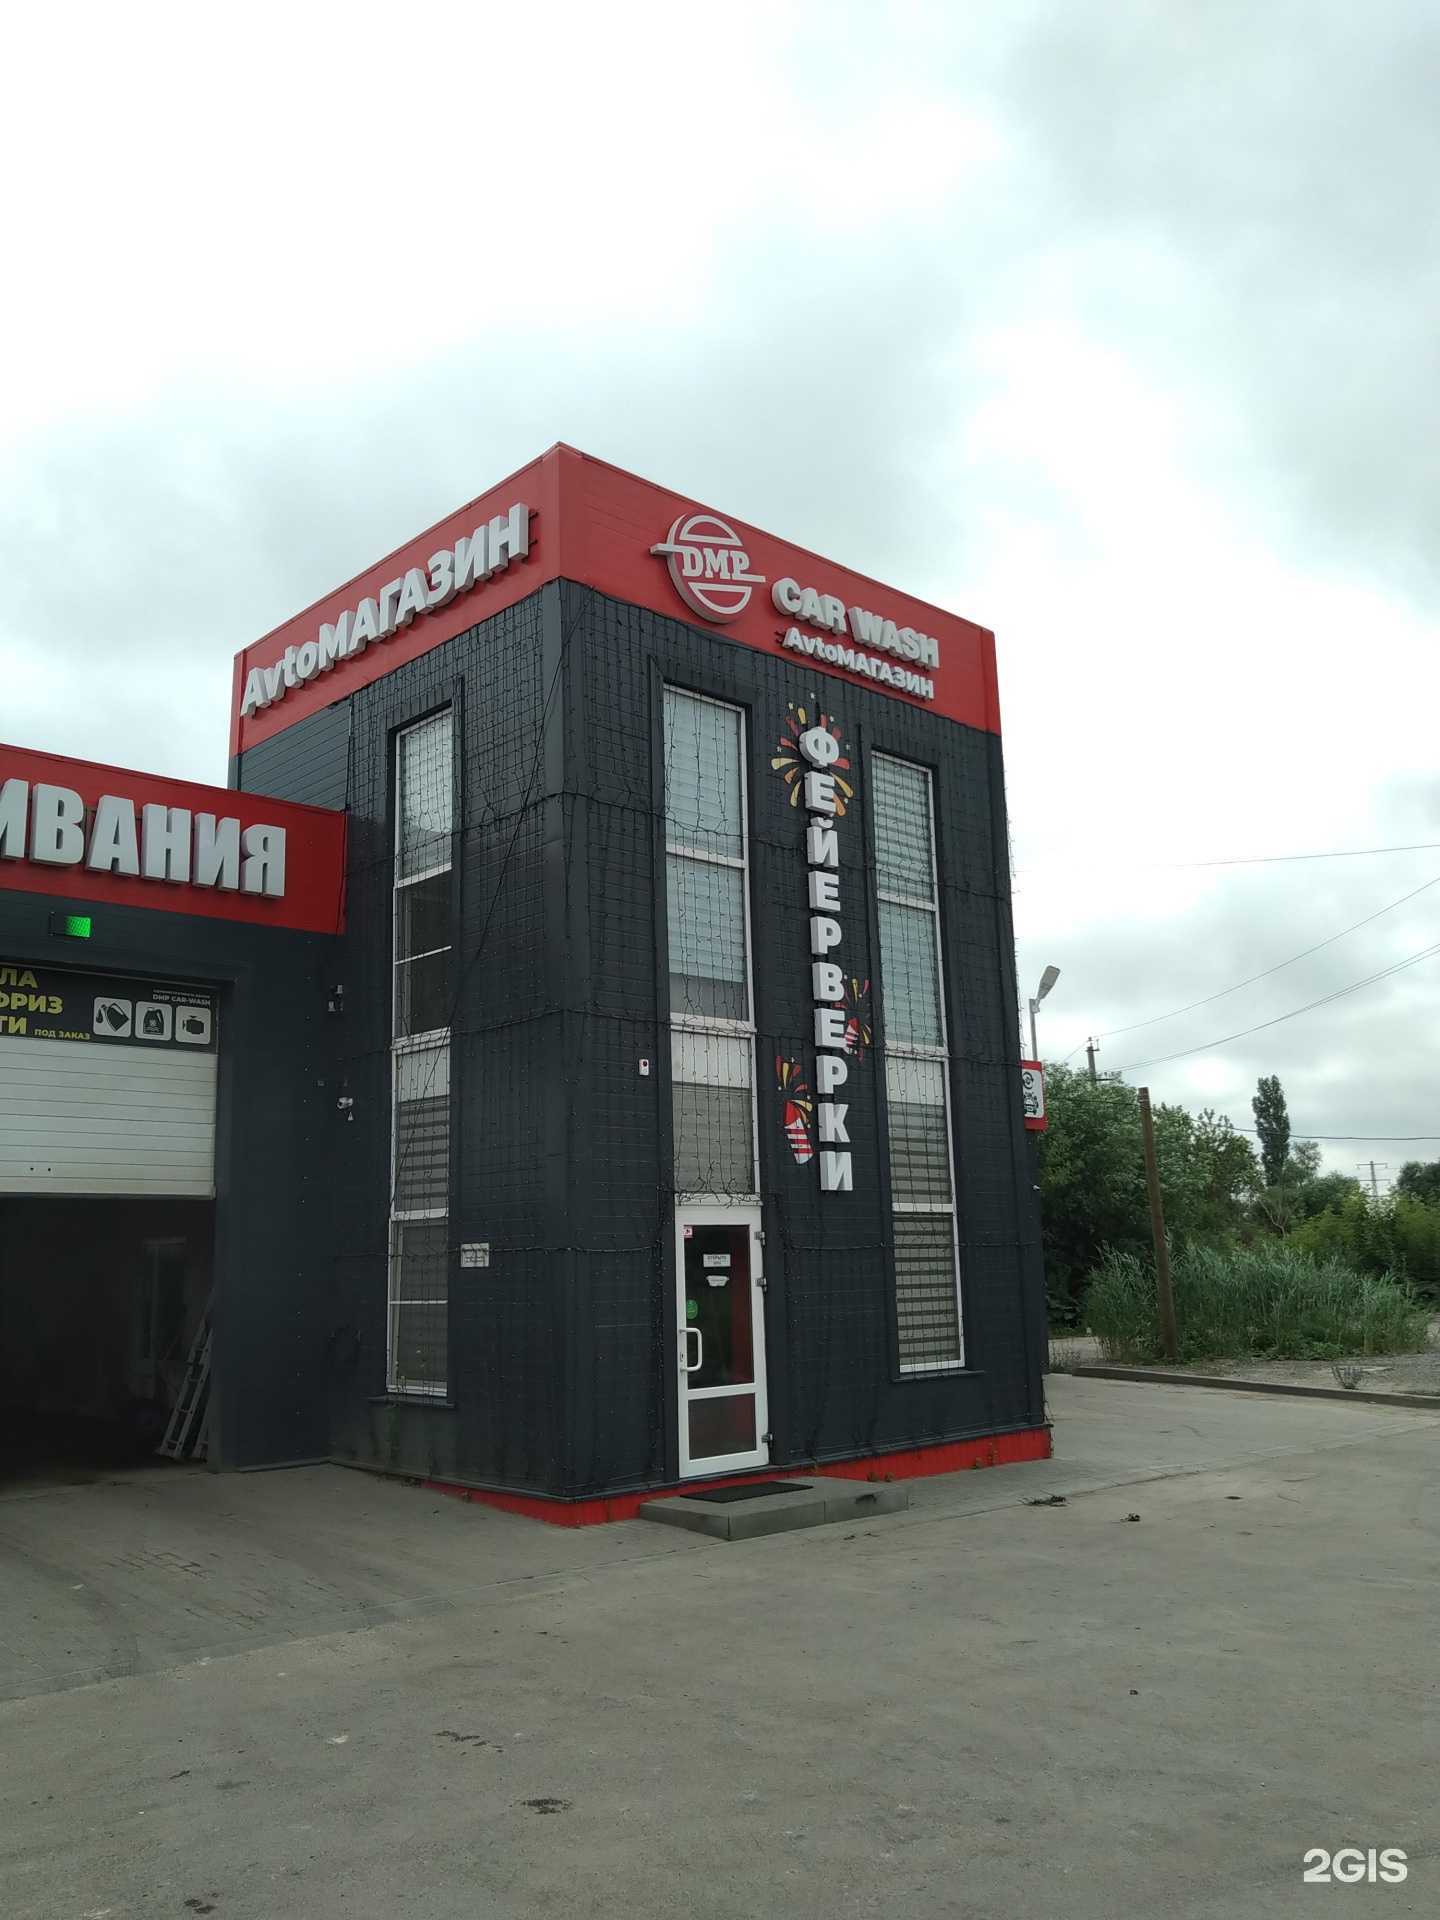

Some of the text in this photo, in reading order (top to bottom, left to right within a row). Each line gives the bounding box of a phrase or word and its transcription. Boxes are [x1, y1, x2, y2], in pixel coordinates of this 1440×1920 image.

[681, 545, 751, 581] DMP
[771, 577, 940, 672] CAR WASH
[799, 726, 854, 1191] ФЕЙЕРВЕРКИ
[34, 1028, 57, 1038] ПОД
[58, 1031, 91, 1040] ЗАКАЗ
